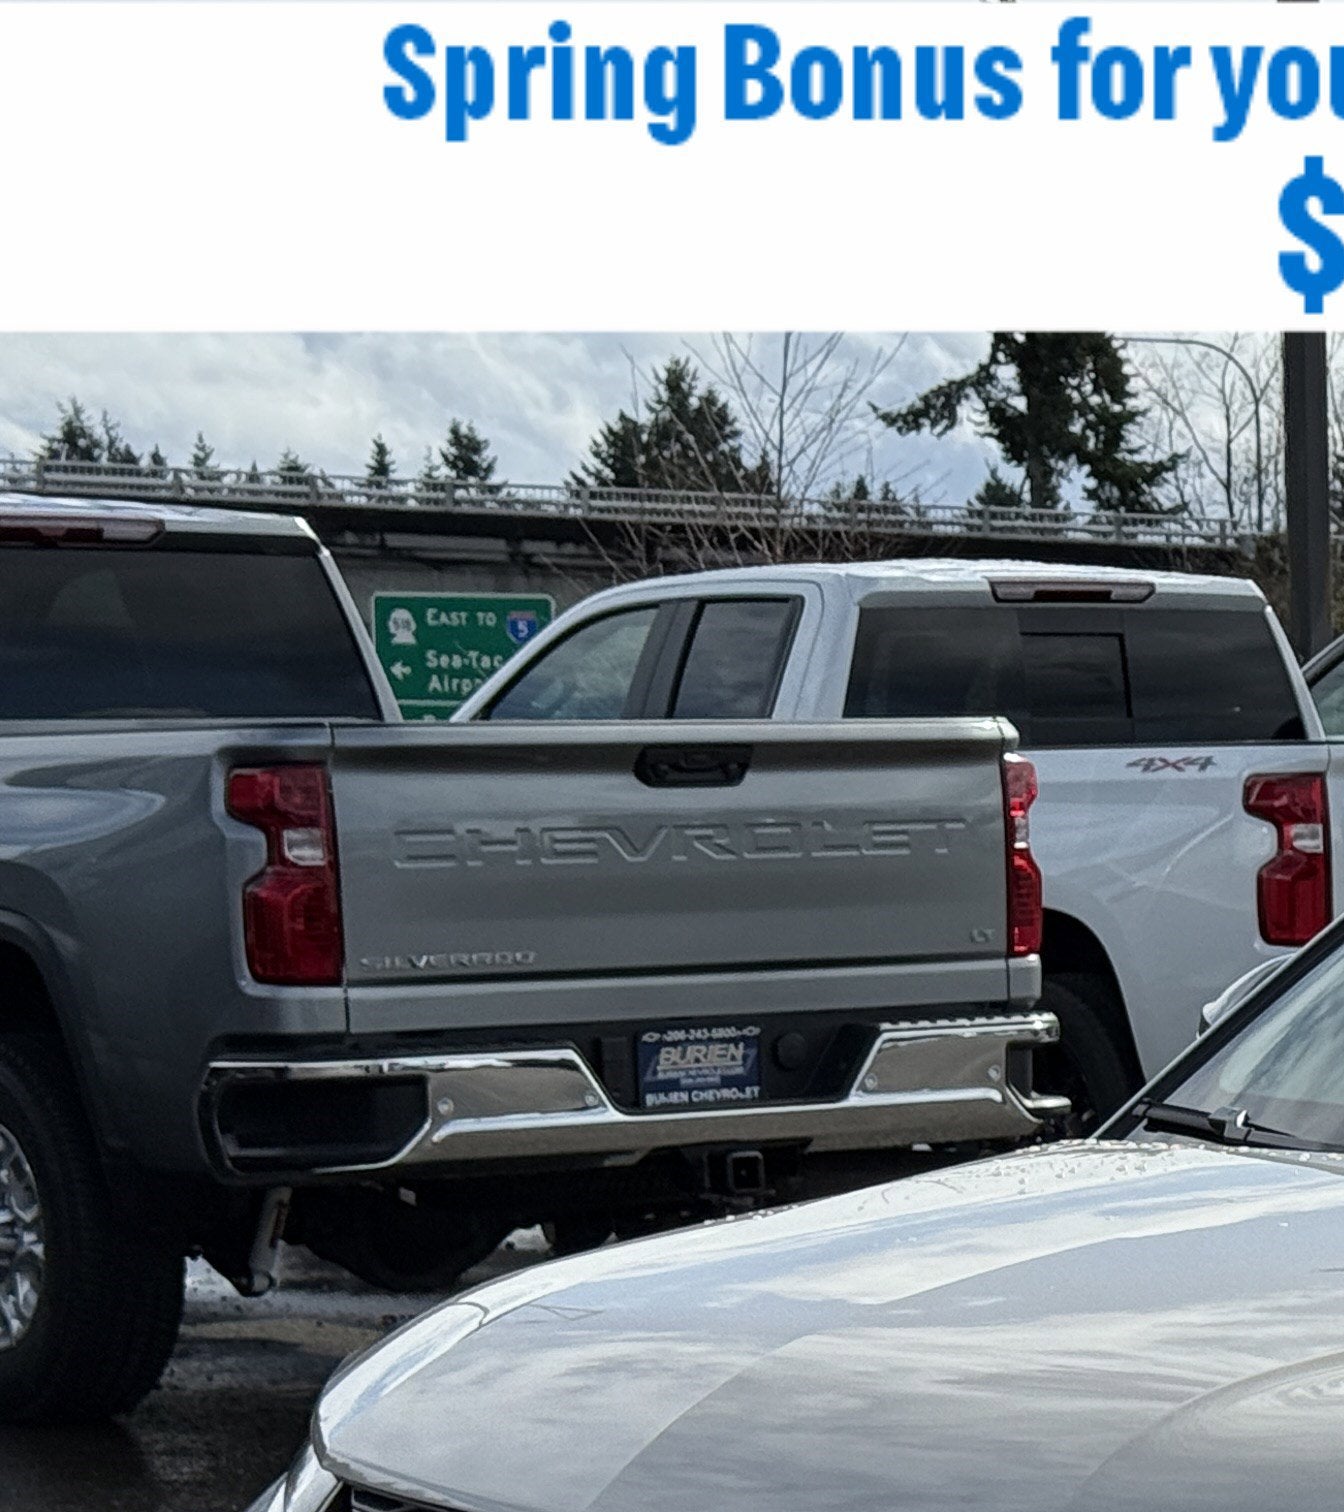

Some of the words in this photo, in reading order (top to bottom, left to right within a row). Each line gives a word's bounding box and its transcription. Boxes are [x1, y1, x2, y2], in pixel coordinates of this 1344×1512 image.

[394, 818, 970, 868] CHEVROLET
[360, 950, 538, 972] SILVERADO
[659, 1041, 745, 1066] BURIEN
